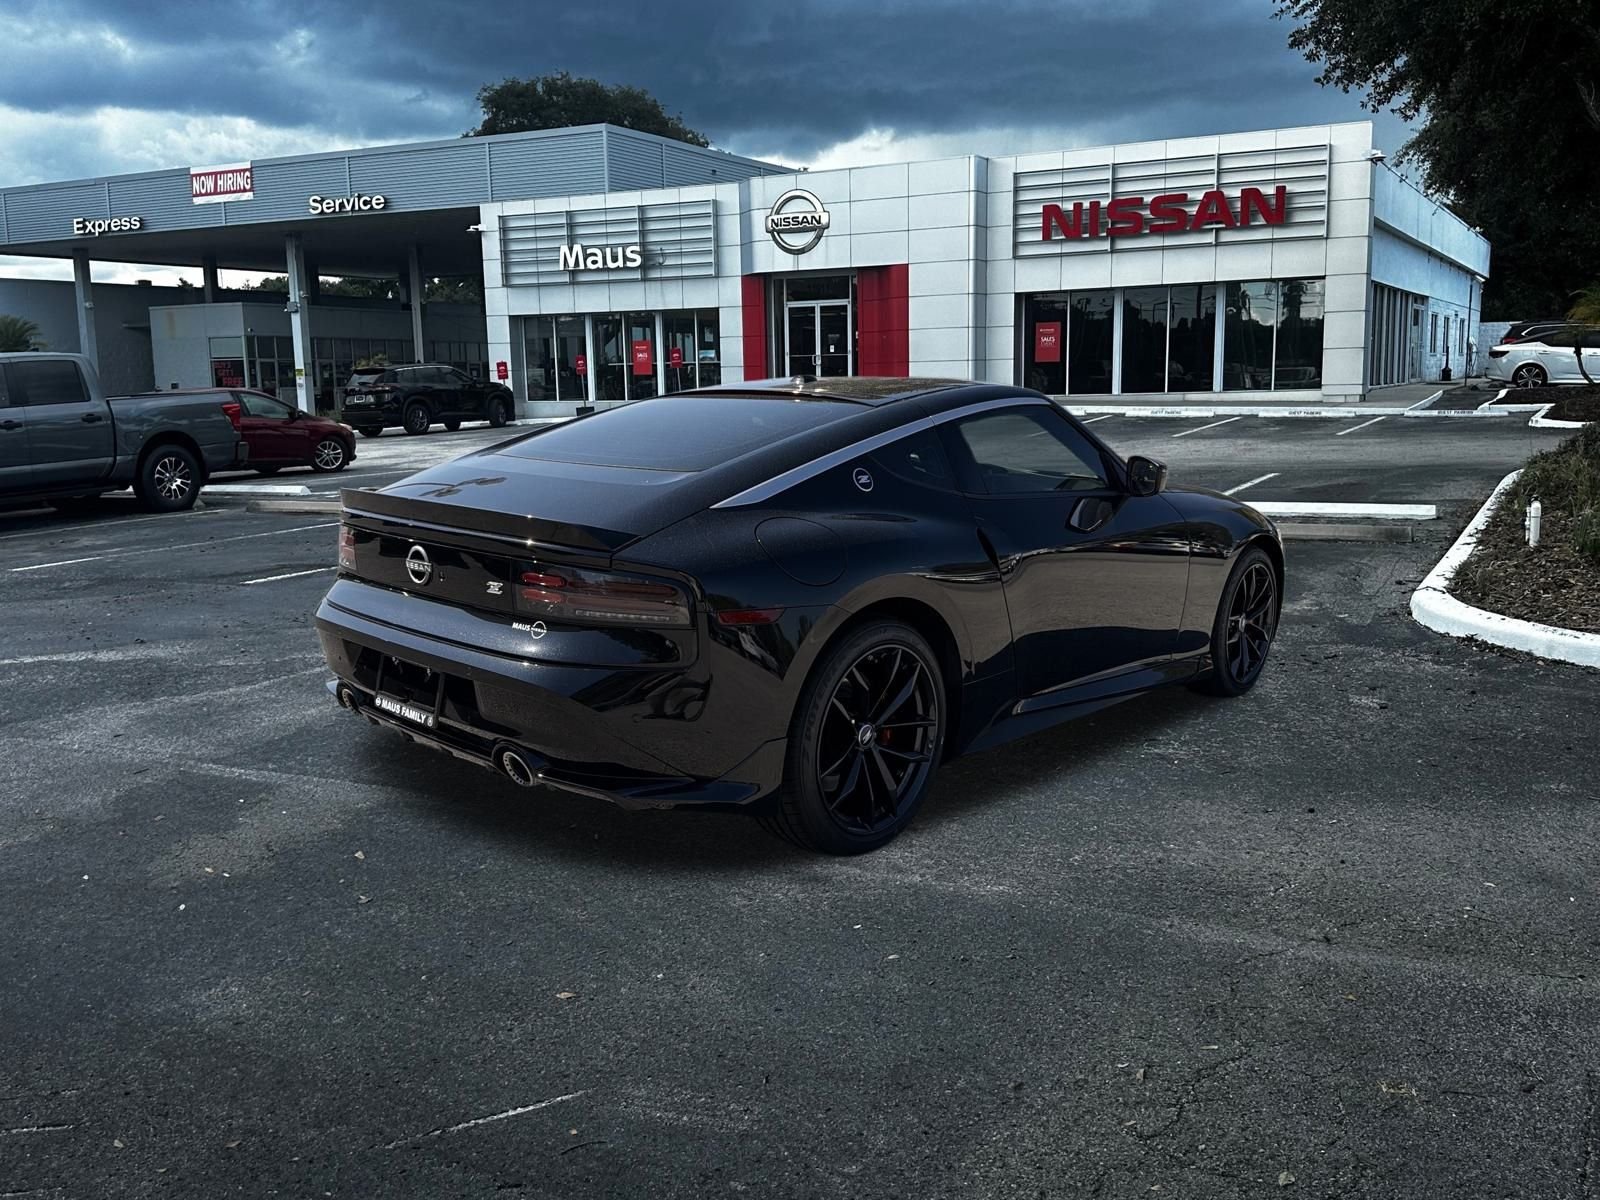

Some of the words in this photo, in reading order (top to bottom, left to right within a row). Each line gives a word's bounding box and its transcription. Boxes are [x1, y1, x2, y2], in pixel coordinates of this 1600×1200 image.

[192, 174, 216, 195] NOW
[217, 171, 251, 193] HIRING
[308, 192, 386, 215] Service
[1041, 185, 1287, 241] NISSAN
[73, 216, 141, 237] Express
[770, 214, 822, 229] NISSAN
[559, 243, 642, 271] Maus
[511, 621, 531, 632] MAUS
[381, 698, 400, 714] MAUS
[401, 706, 427, 724] FAMILY
